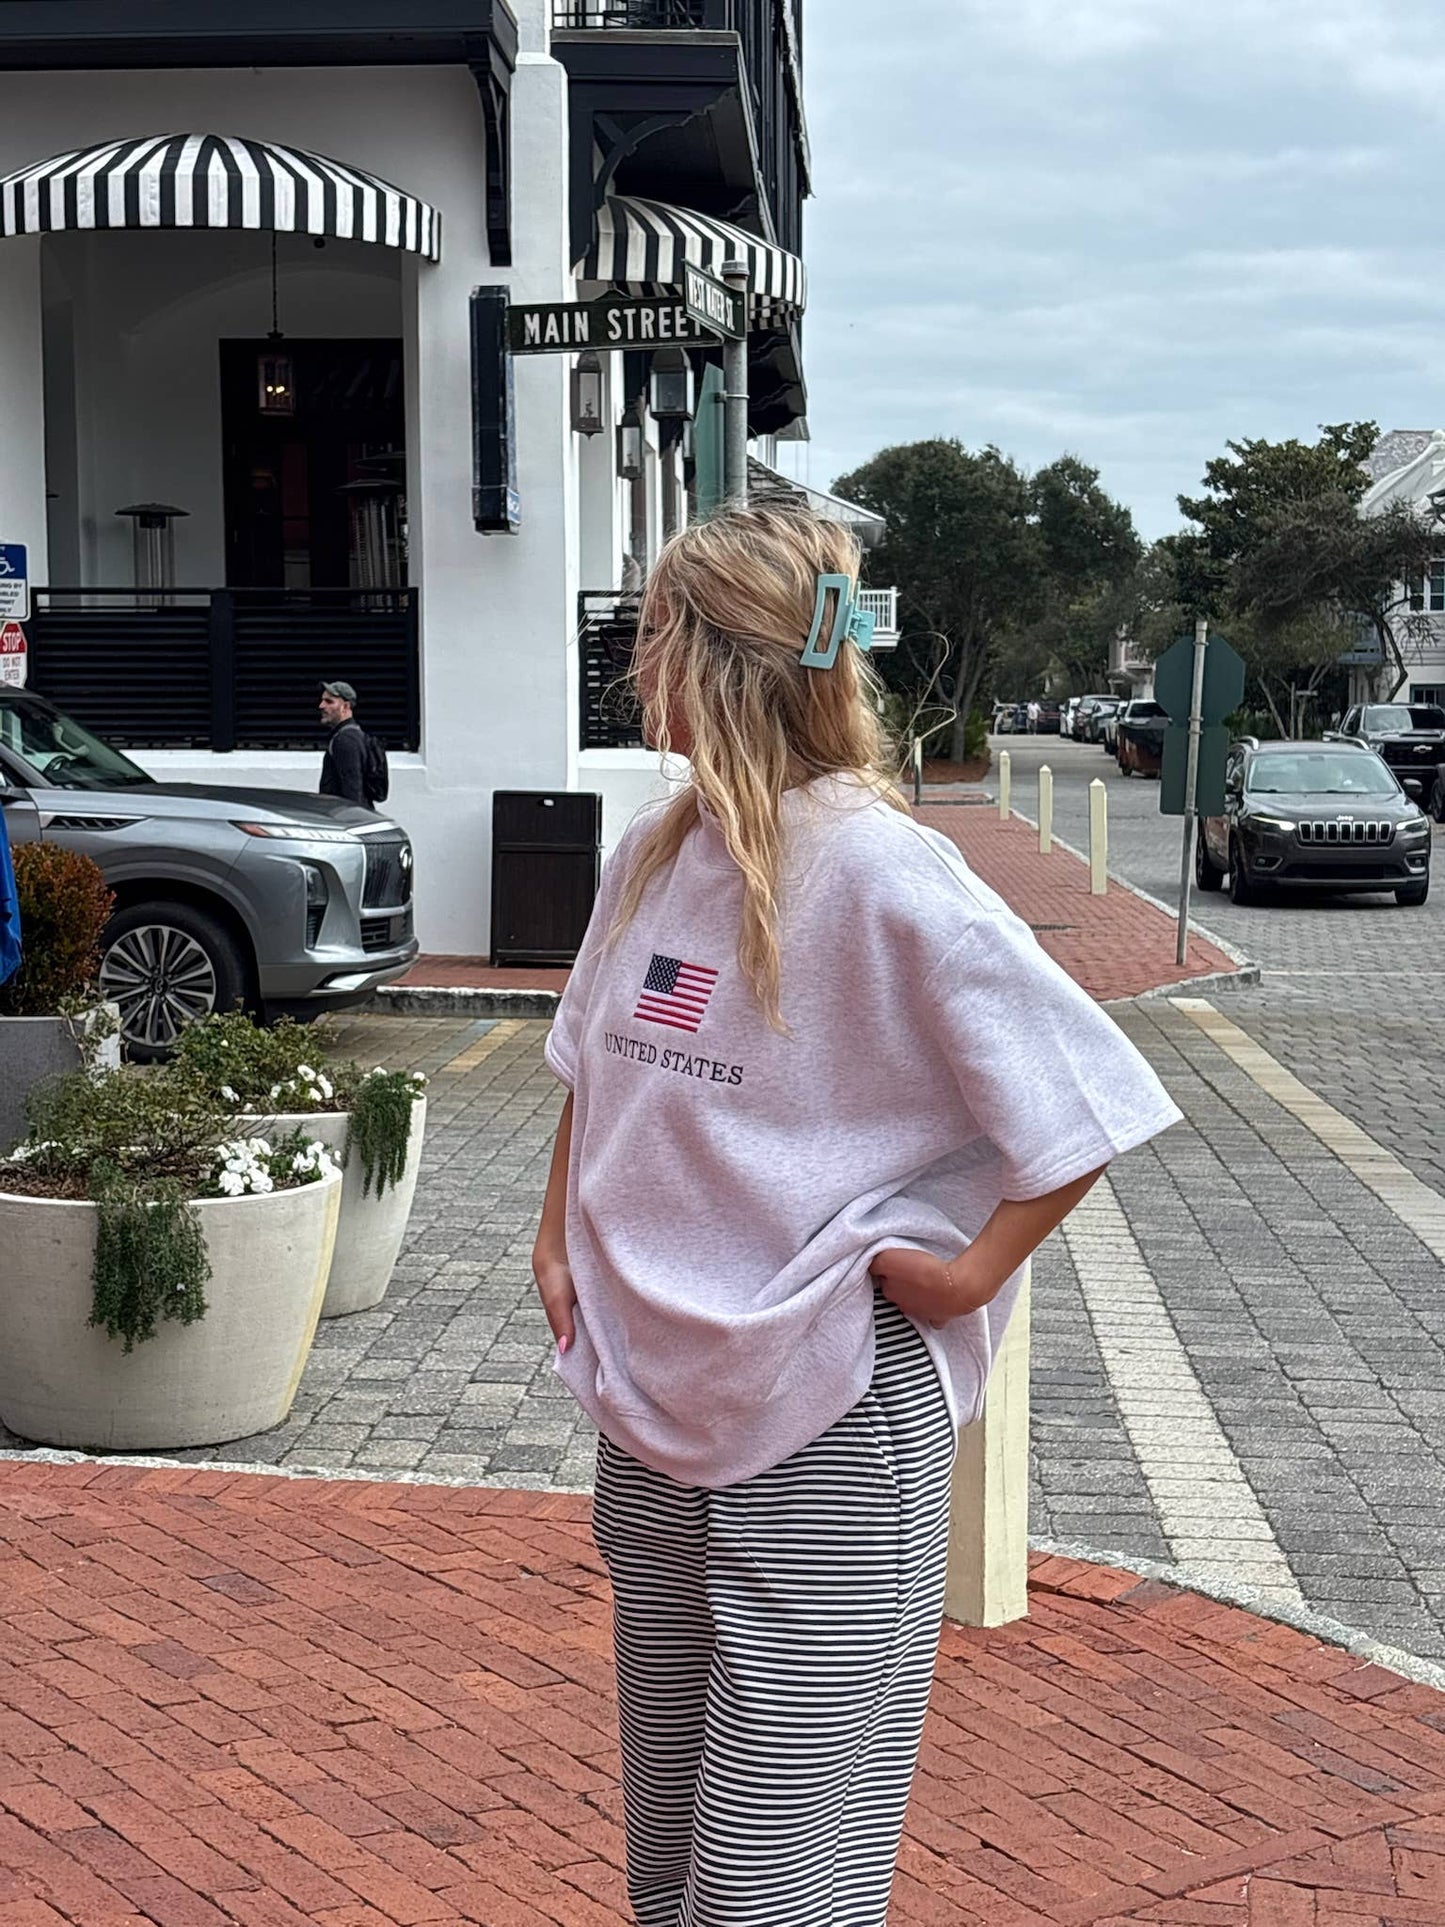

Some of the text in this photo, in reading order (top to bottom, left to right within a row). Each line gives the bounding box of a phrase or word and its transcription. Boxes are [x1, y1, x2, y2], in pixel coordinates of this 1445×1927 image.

[524, 311, 590, 345] MAIN
[3, 632, 21, 652] STOP
[604, 1032, 744, 1086] UNITED STATES
